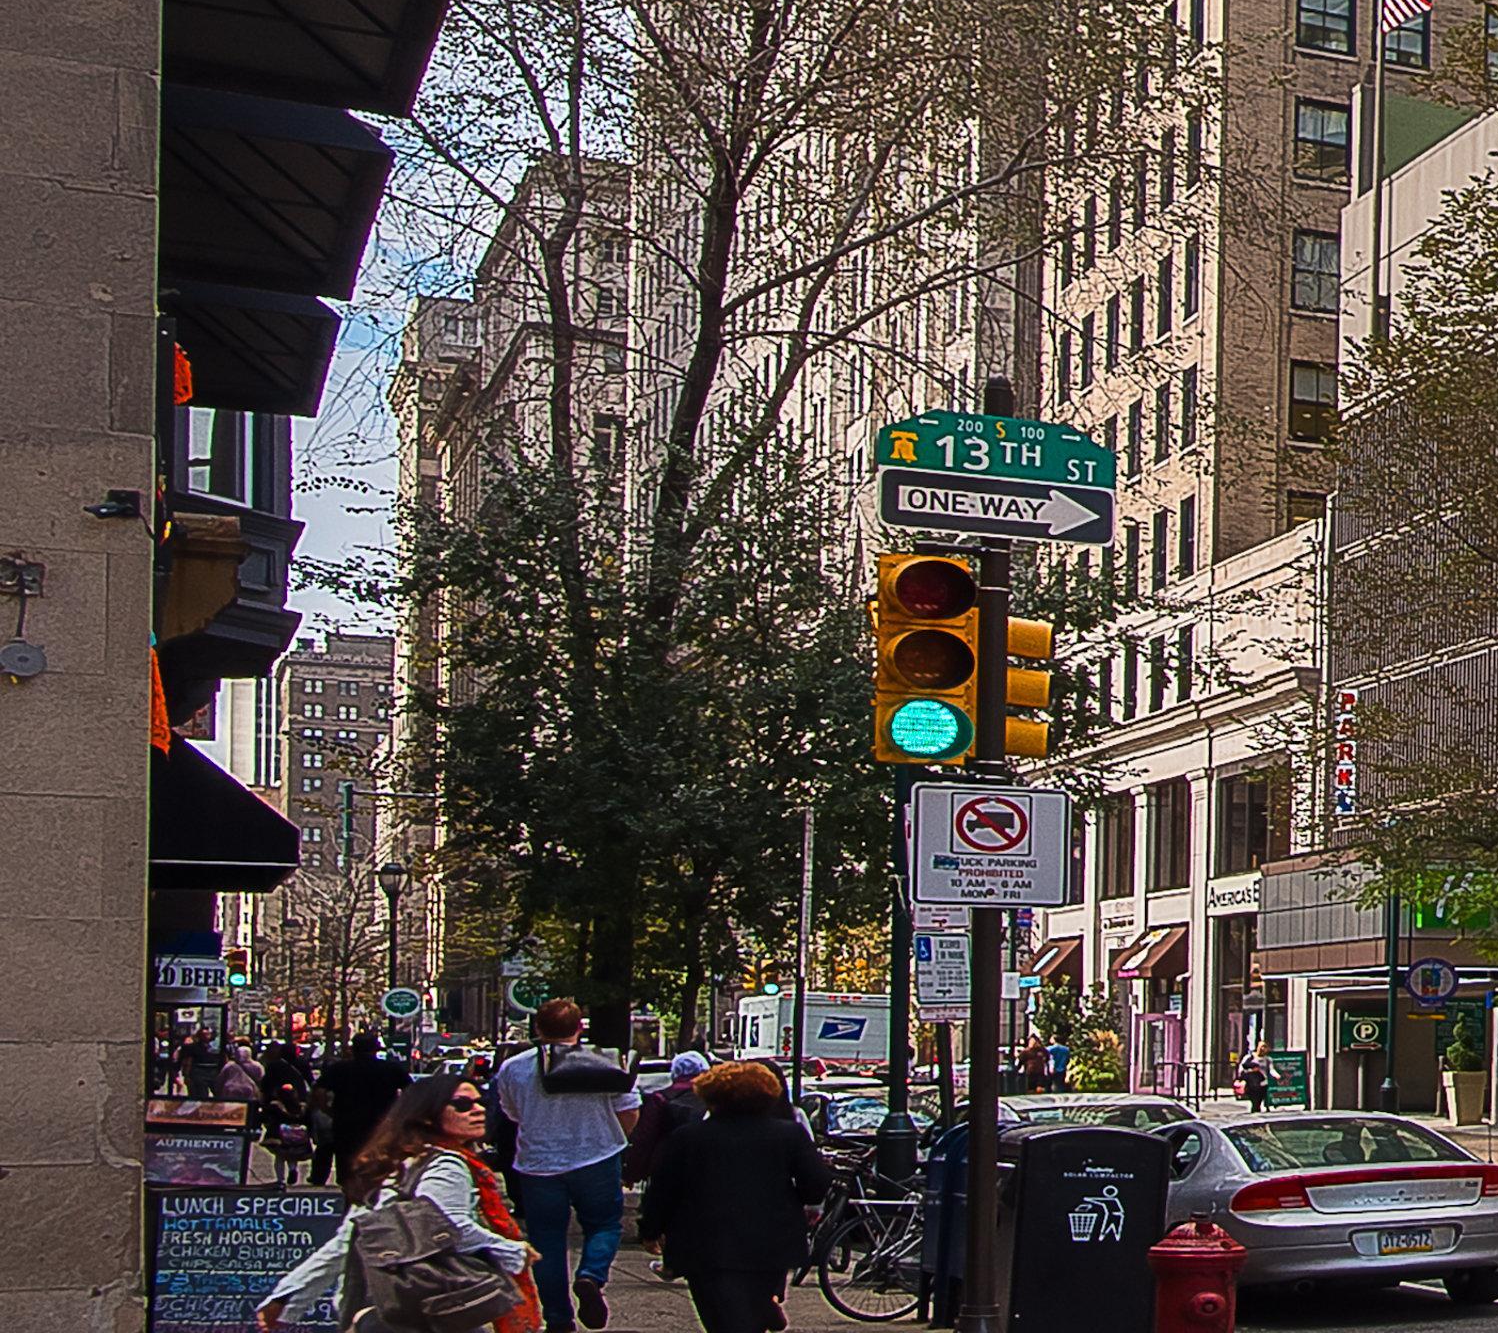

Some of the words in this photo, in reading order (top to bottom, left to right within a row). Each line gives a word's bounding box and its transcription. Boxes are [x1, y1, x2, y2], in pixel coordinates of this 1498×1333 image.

[957, 418, 984, 433] 200
[995, 421, 1006, 438] S
[1021, 426, 1045, 440] 100
[936, 435, 1041, 471] 13TH
[1067, 459, 1097, 482] ST
[907, 488, 969, 514] ONE
[979, 494, 1046, 521] WAY
[1339, 693, 1355, 786] PARK
[988, 859, 1037, 868] PARKING
[959, 869, 1024, 878] PROHIBITED
[952, 879, 962, 888] 10
[966, 880, 985, 888] AM
[1012, 881, 1032, 889] AM
[961, 890, 986, 898] MON
[1003, 891, 1021, 899] FRI
[180, 967, 225, 987] BEER
[1360, 1024, 1373, 1039] P
[156, 1138, 235, 1150] AUTHENTIC
[162, 1197, 224, 1215] LUNCH
[236, 1197, 336, 1216] SPECIALS
[162, 1232, 212, 1245] FRESH
[218, 1231, 313, 1246] HORCHATA
[169, 1245, 231, 1258] CHICKEN
